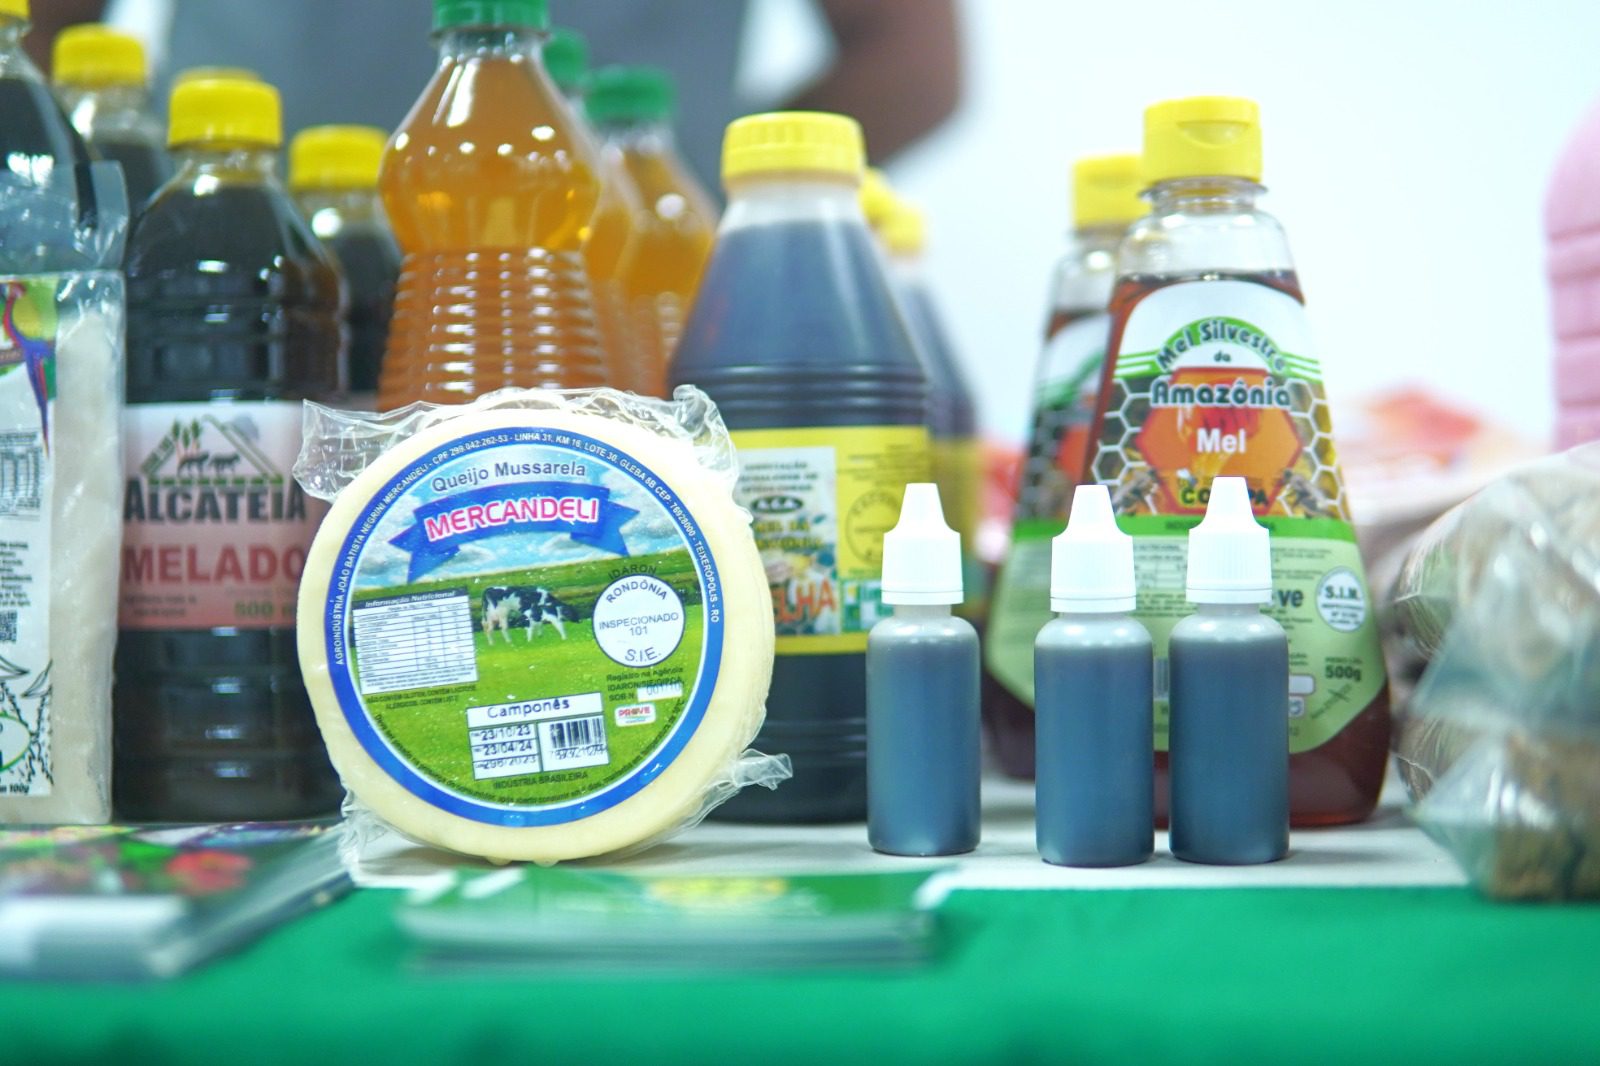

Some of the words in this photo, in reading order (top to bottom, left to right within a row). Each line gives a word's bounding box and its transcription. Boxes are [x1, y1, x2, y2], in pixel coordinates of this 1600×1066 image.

[1157, 328, 1194, 369] Mel
[1201, 321, 1285, 371] Silvestre
[1214, 351, 1231, 362] da
[1151, 378, 1291, 406] Amazônia
[1197, 429, 1245, 453] Mel
[432, 468, 489, 492] Queijo
[494, 461, 585, 477] Mussarela
[124, 478, 306, 521] ALCATEIA
[347, 535, 364, 568] BATISTA
[361, 504, 385, 534] NEGRINI
[383, 464, 428, 506] MERCANDELI
[432, 451, 449, 465] CPF
[515, 433, 540, 442] LINHA
[556, 436, 569, 445] KM
[584, 441, 606, 456] LOTE
[620, 459, 645, 481] GLEBA
[710, 608, 719, 622] RO
[425, 498, 598, 540] MERCANDELI
[124, 544, 306, 583] MELADO
[608, 563, 656, 579] IDARON
[599, 612, 679, 630] INSPECIONADO
[629, 626, 648, 636] 101
[1325, 665, 1361, 682] 500g
[487, 697, 570, 718] Camponês
[481, 723, 531, 741] 23/10/23
